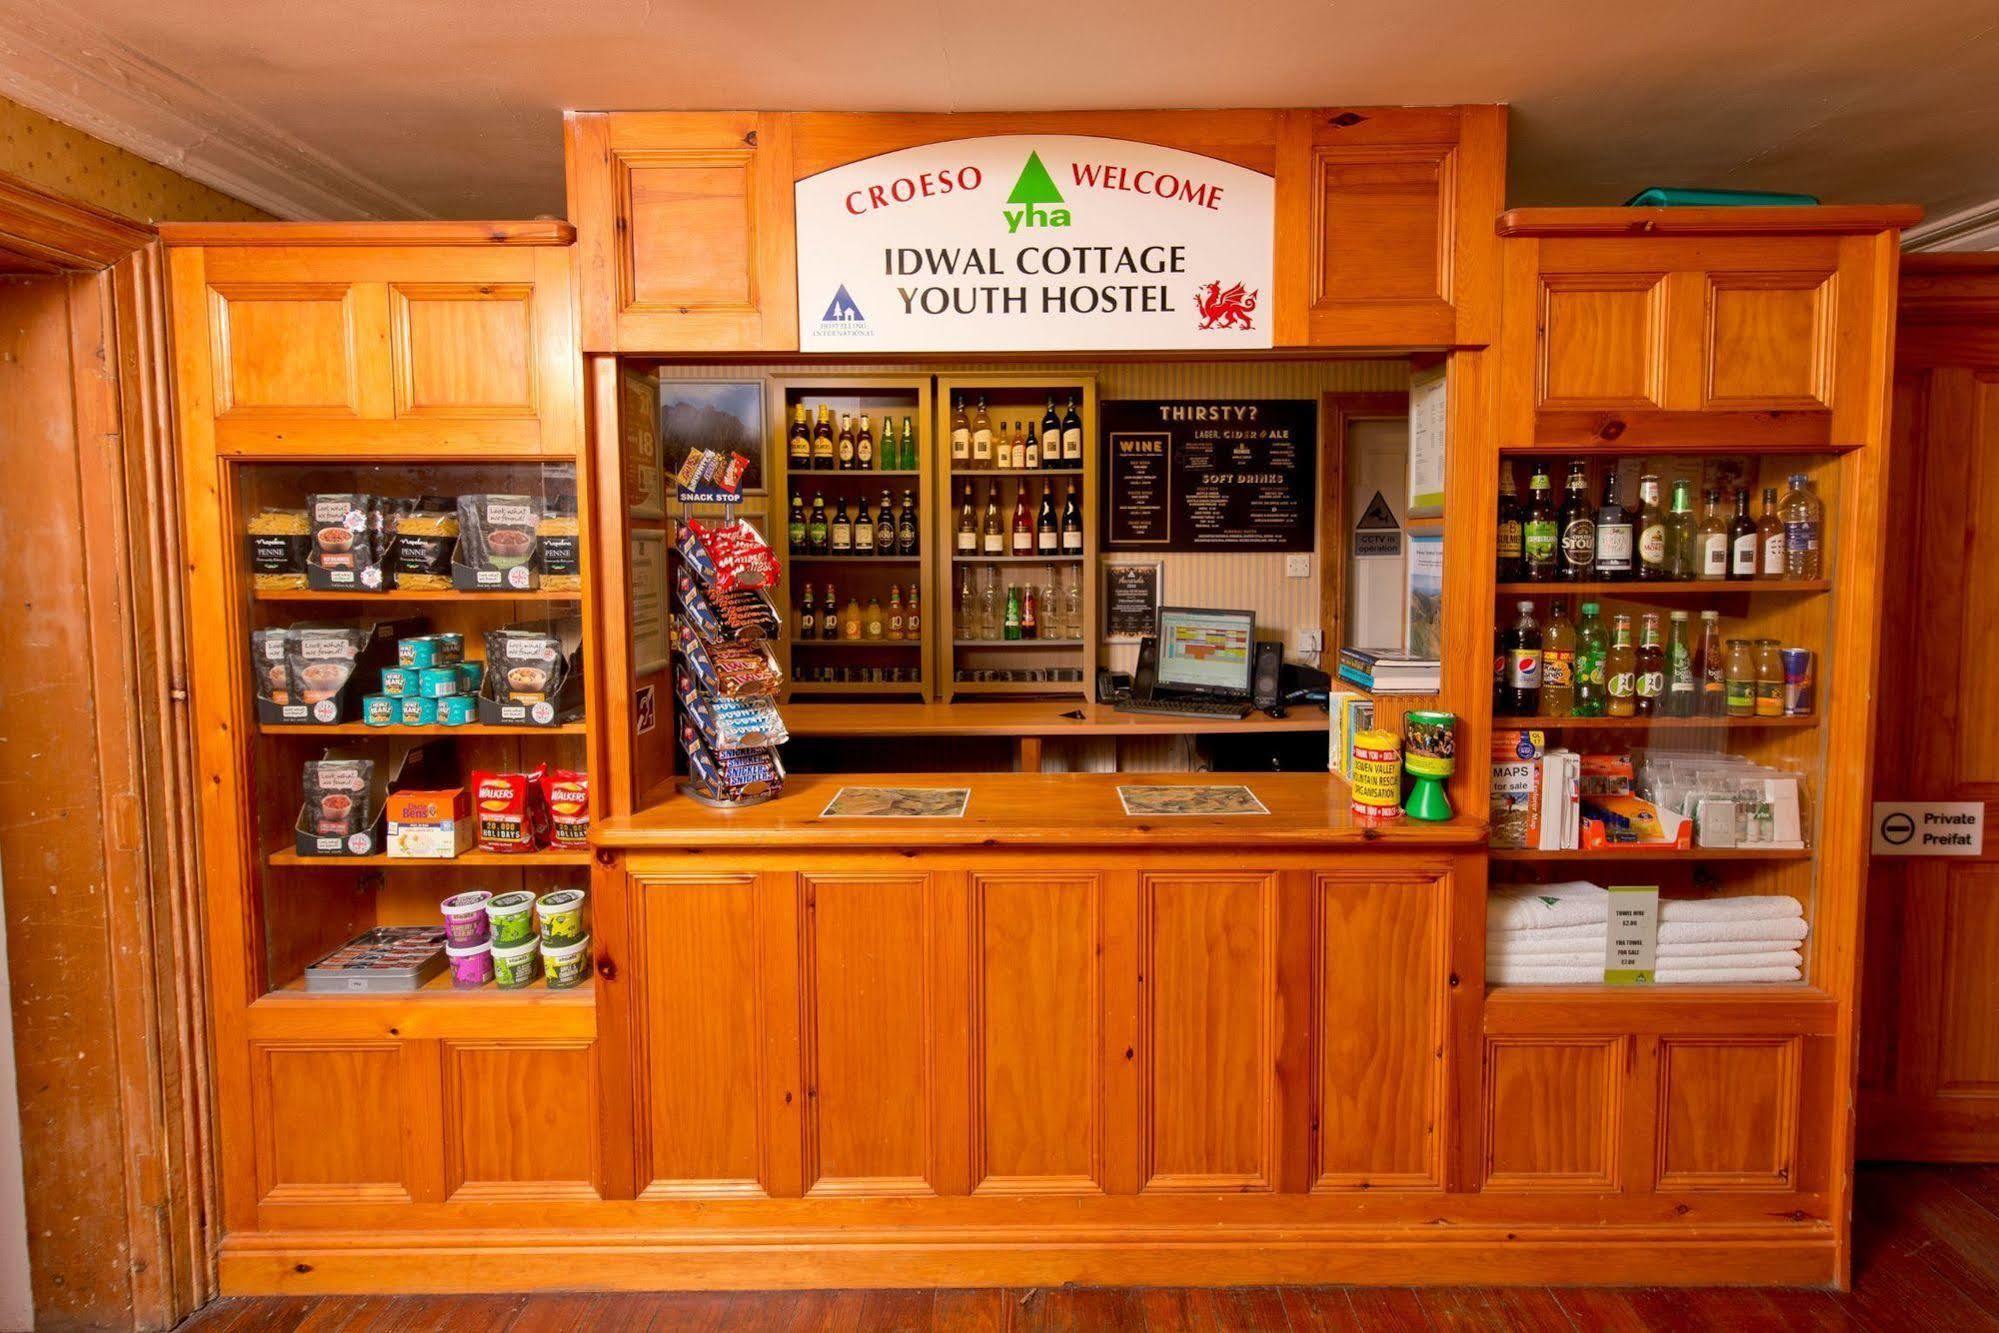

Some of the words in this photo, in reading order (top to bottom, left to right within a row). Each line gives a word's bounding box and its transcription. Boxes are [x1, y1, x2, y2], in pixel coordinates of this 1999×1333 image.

[845, 165, 982, 215] CROESO
[1071, 162, 1224, 210] WELCOME
[1002, 203, 1072, 233] yha
[884, 247, 1004, 276] IDWAL
[1016, 245, 1186, 275] COTTAGE
[897, 285, 1027, 315] YOUTH
[1042, 284, 1176, 314] HOSTEL
[1160, 406, 1258, 421] THIRSTY?
[1268, 430, 1290, 439] ALE
[1119, 441, 1164, 453] WINE
[1202, 474, 1234, 484] SOFT
[1237, 474, 1284, 484] DRINKS
[680, 493, 714, 501] SNACK
[1361, 535, 1386, 544] CCTV
[1358, 544, 1398, 553] operation
[1375, 763, 1395, 774] VALLEY
[1493, 766, 1529, 777] MAPS
[1494, 782, 1507, 791] for
[1509, 781, 1528, 791] sale
[479, 788, 514, 799] WALKERS
[551, 790, 586, 802] WALKERS
[1924, 812, 1976, 825] Private
[483, 829, 521, 838] HOLIDAYS
[557, 830, 587, 838] HOLIDAY
[1923, 833, 1972, 845] Preifat
